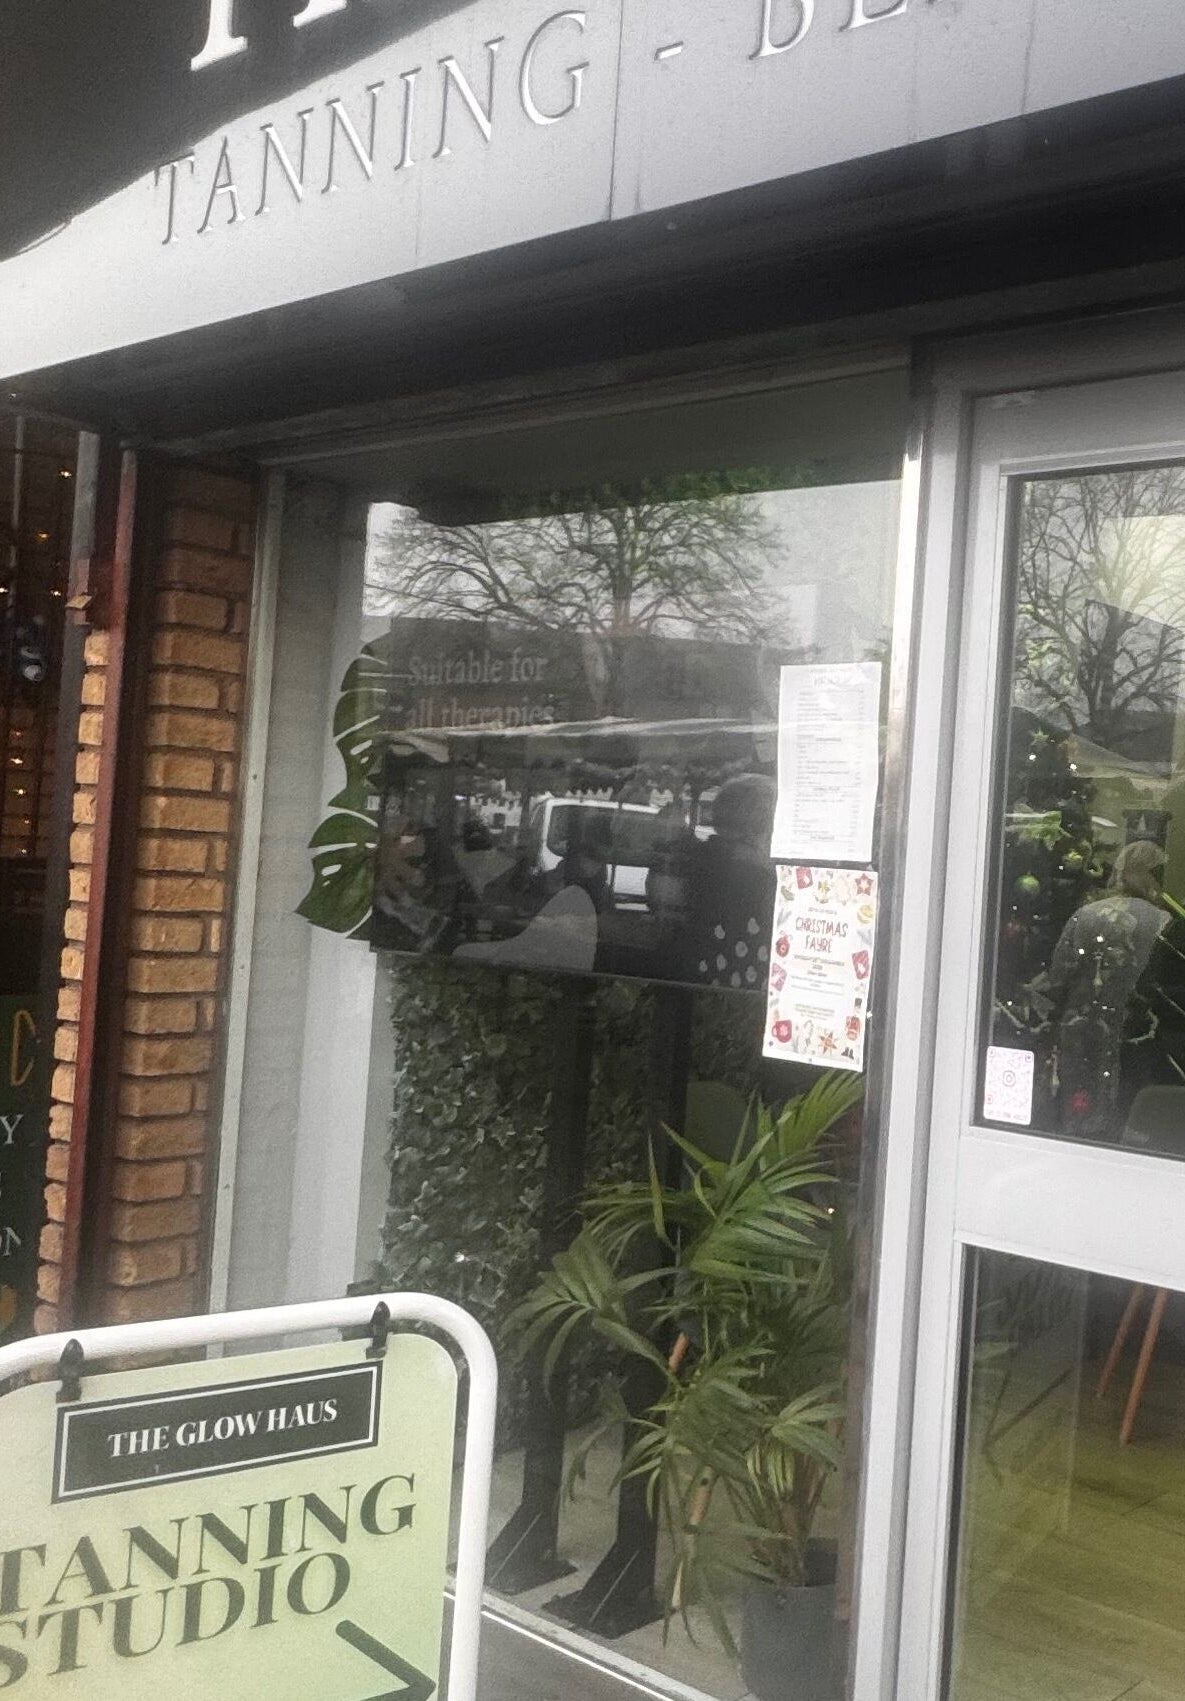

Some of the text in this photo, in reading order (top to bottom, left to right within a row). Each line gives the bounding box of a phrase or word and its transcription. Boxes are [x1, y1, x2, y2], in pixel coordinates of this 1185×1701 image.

[153, 9, 590, 246] TANNING
[408, 646, 549, 686] Suitable for
[795, 916, 849, 938] CHRISTMAS
[804, 935, 833, 954] FAYRE
[107, 1399, 338, 1457] THE GLOW HAUS
[0, 1473, 416, 1618] TANNING
